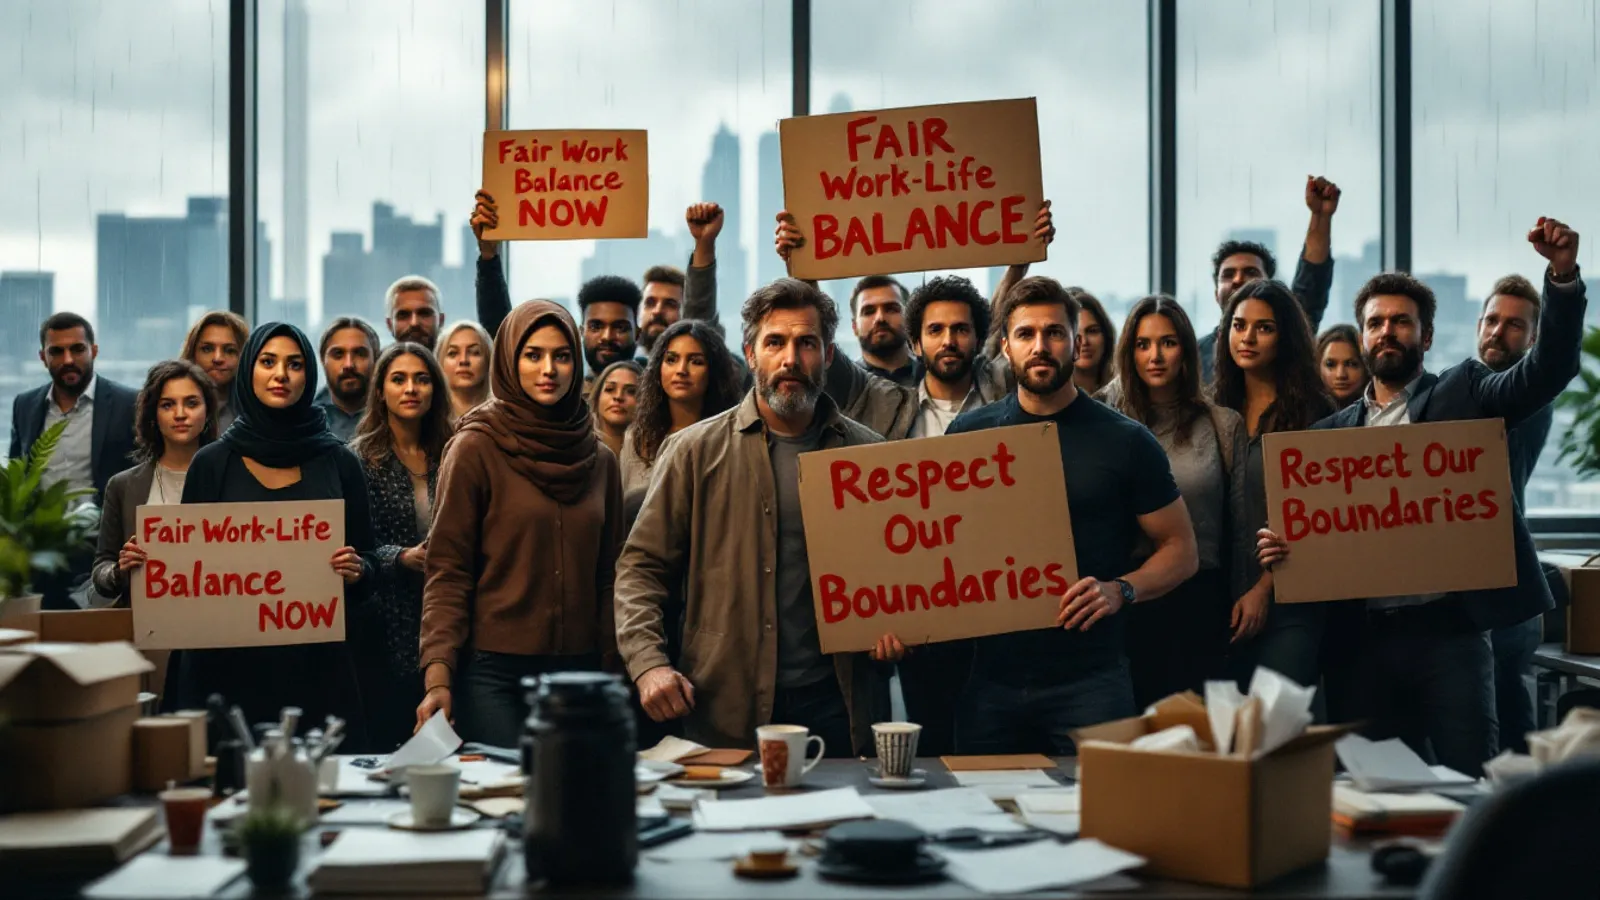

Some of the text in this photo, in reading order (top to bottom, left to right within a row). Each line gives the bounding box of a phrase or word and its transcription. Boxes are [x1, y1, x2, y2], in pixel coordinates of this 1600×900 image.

[499, 138, 628, 164] Fair Work
[847, 116, 955, 162] FAIR
[515, 168, 624, 194] Balance
[820, 157, 996, 201] Work-Life
[519, 195, 608, 227] NOW
[813, 196, 1028, 260] BALANCE
[830, 442, 1016, 510] Respect
[1280, 442, 1485, 494] Respect Our
[143, 513, 332, 543] Fair Work-Life
[884, 513, 962, 554] Our
[1282, 486, 1499, 542] Boundaries
[145, 559, 285, 599] Balance
[819, 556, 1069, 623] Boundaries
[258, 597, 338, 632] NOW
